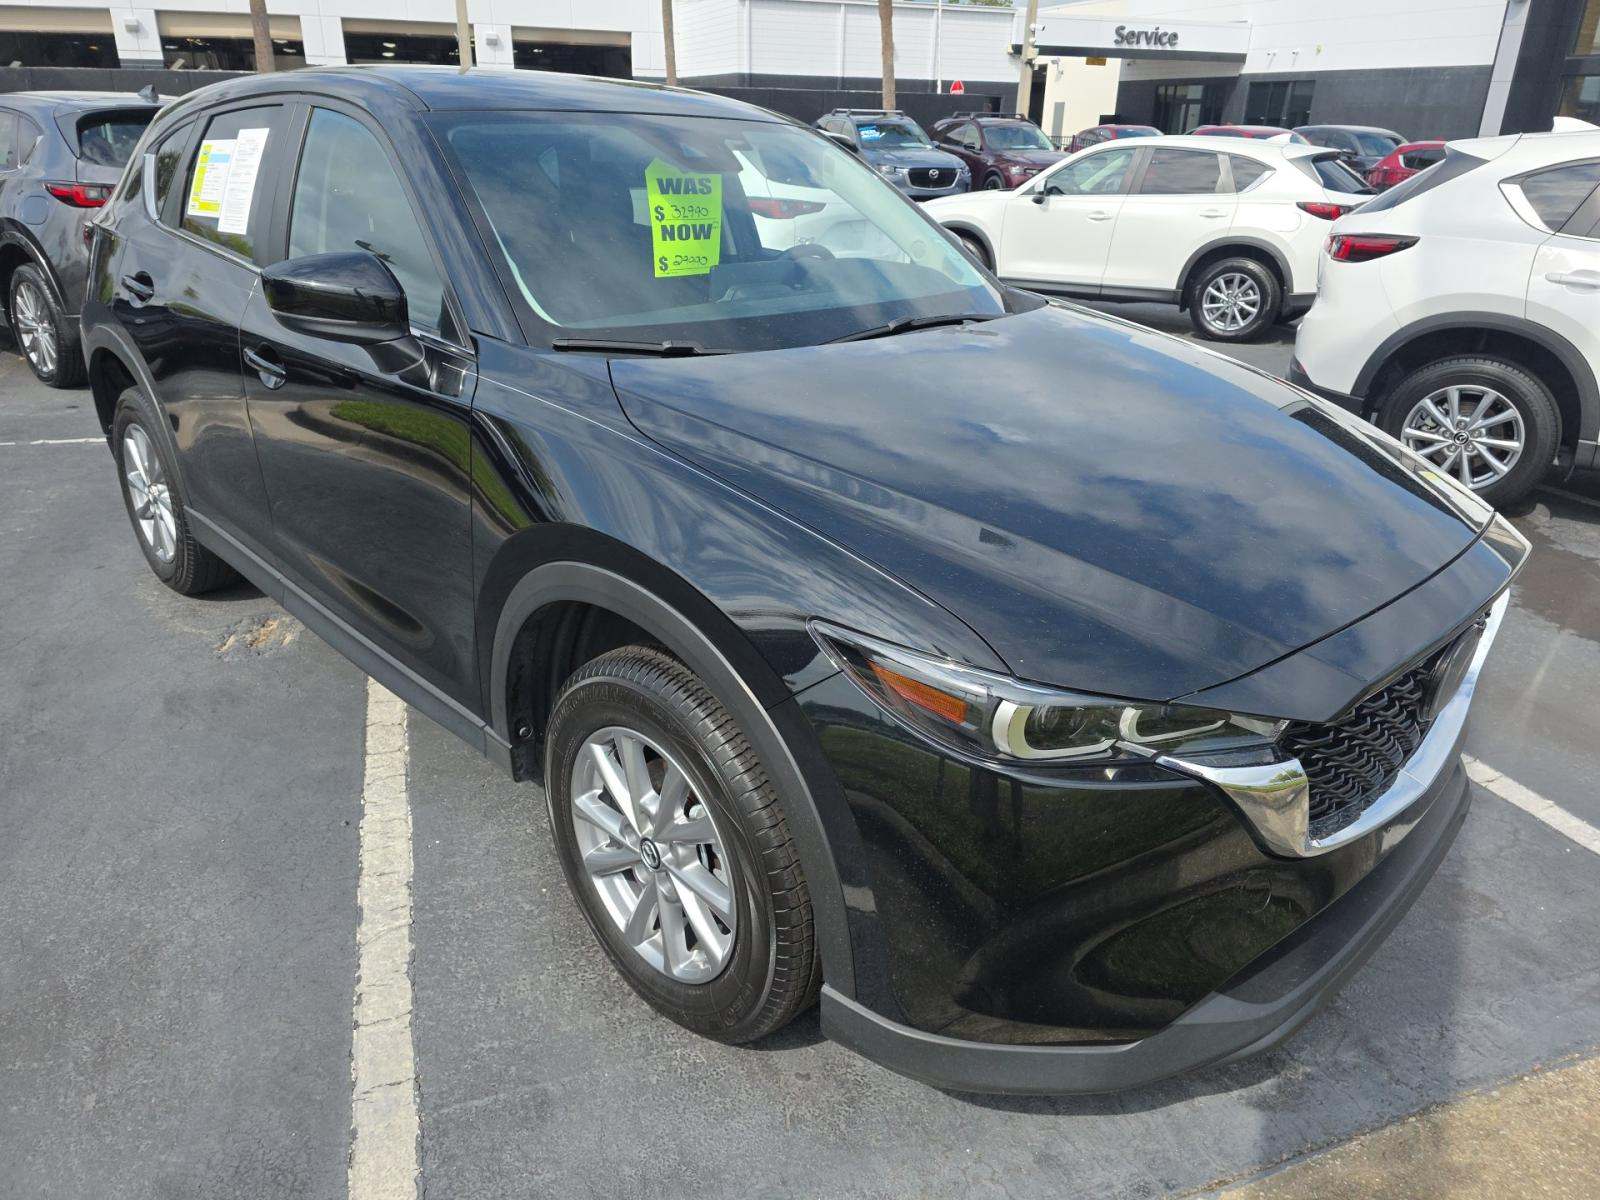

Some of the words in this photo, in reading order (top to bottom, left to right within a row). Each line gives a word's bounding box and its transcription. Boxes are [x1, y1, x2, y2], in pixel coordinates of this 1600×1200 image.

[1114, 25, 1179, 46] Service
[656, 178, 712, 195] WAS
[654, 205, 665, 222] $
[660, 223, 713, 241] NOW
[658, 256, 668, 272] $
